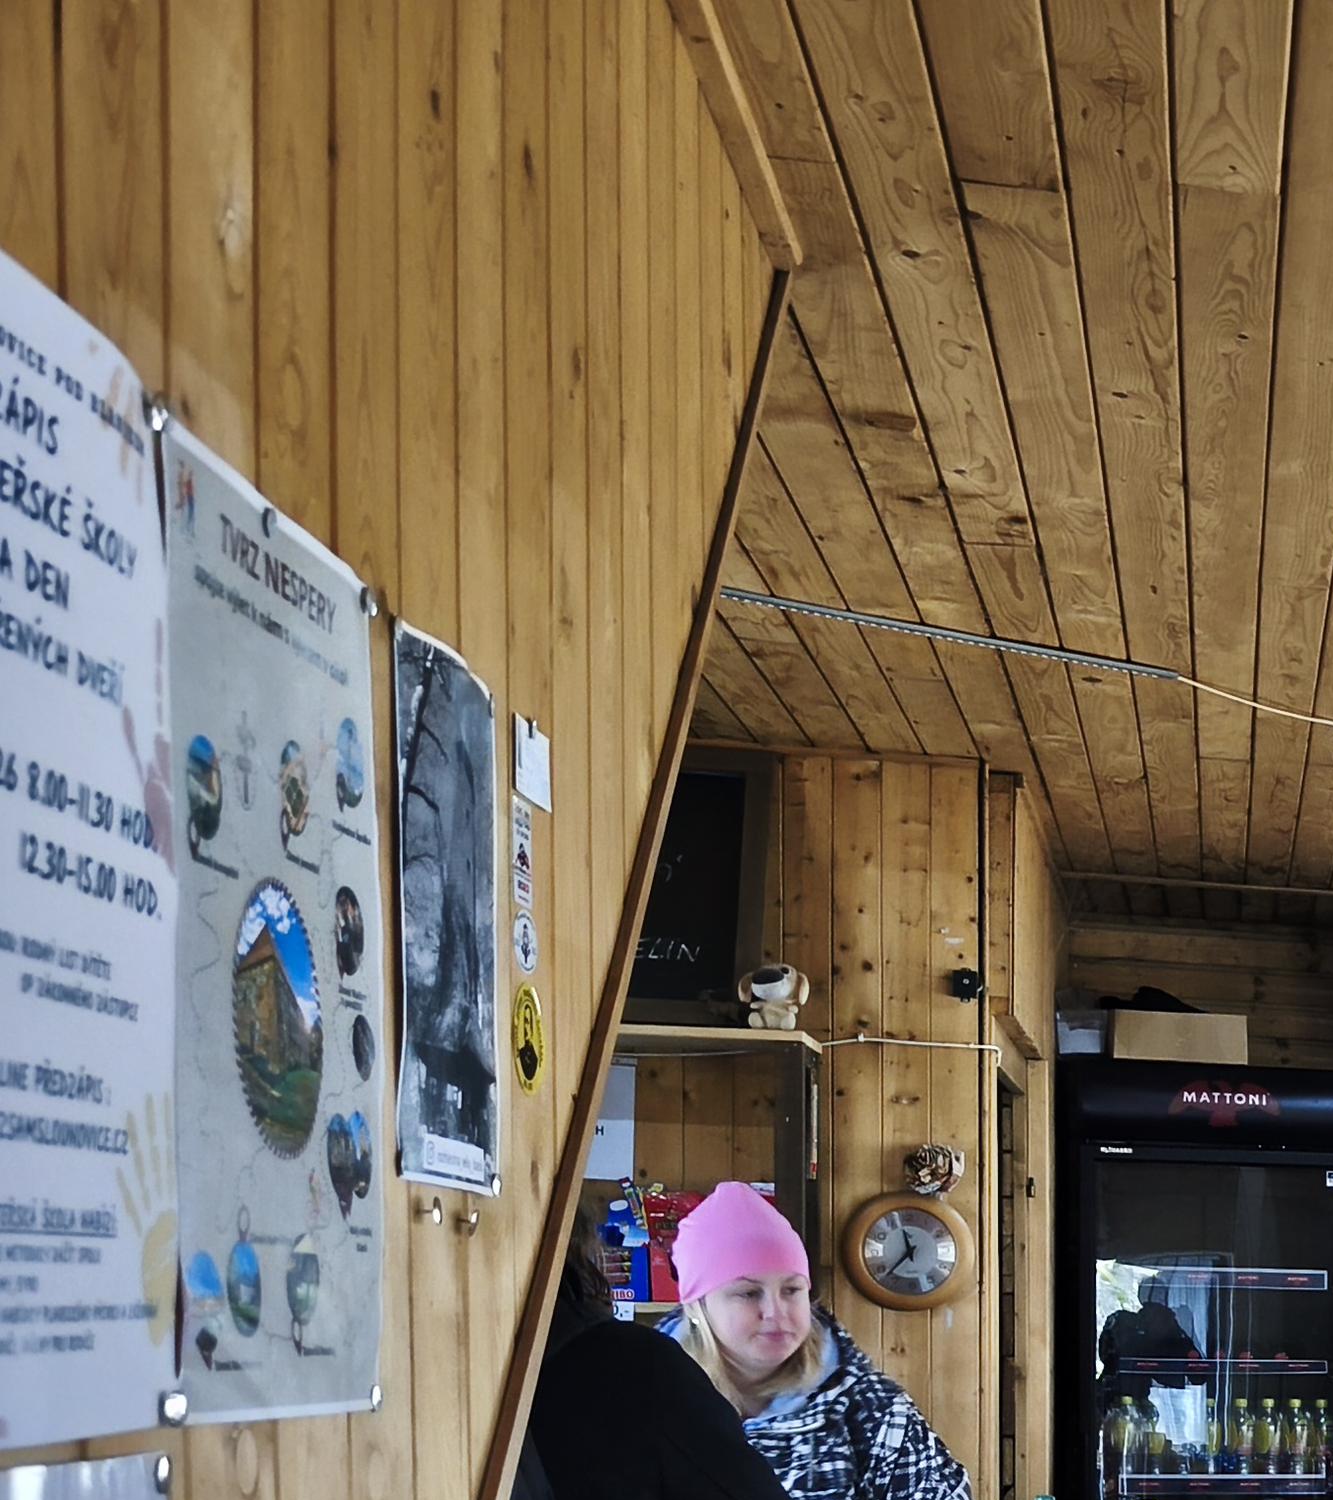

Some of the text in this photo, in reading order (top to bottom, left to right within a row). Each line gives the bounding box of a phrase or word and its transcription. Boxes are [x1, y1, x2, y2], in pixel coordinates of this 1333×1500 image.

[0, 376, 59, 456] ÁPIS
[24, 549, 70, 611] DEN
[220, 513, 337, 634] TVRZ NESPERY
[124, 872, 162, 922] HOD.
[1183, 1091, 1267, 1106] MATTONI
